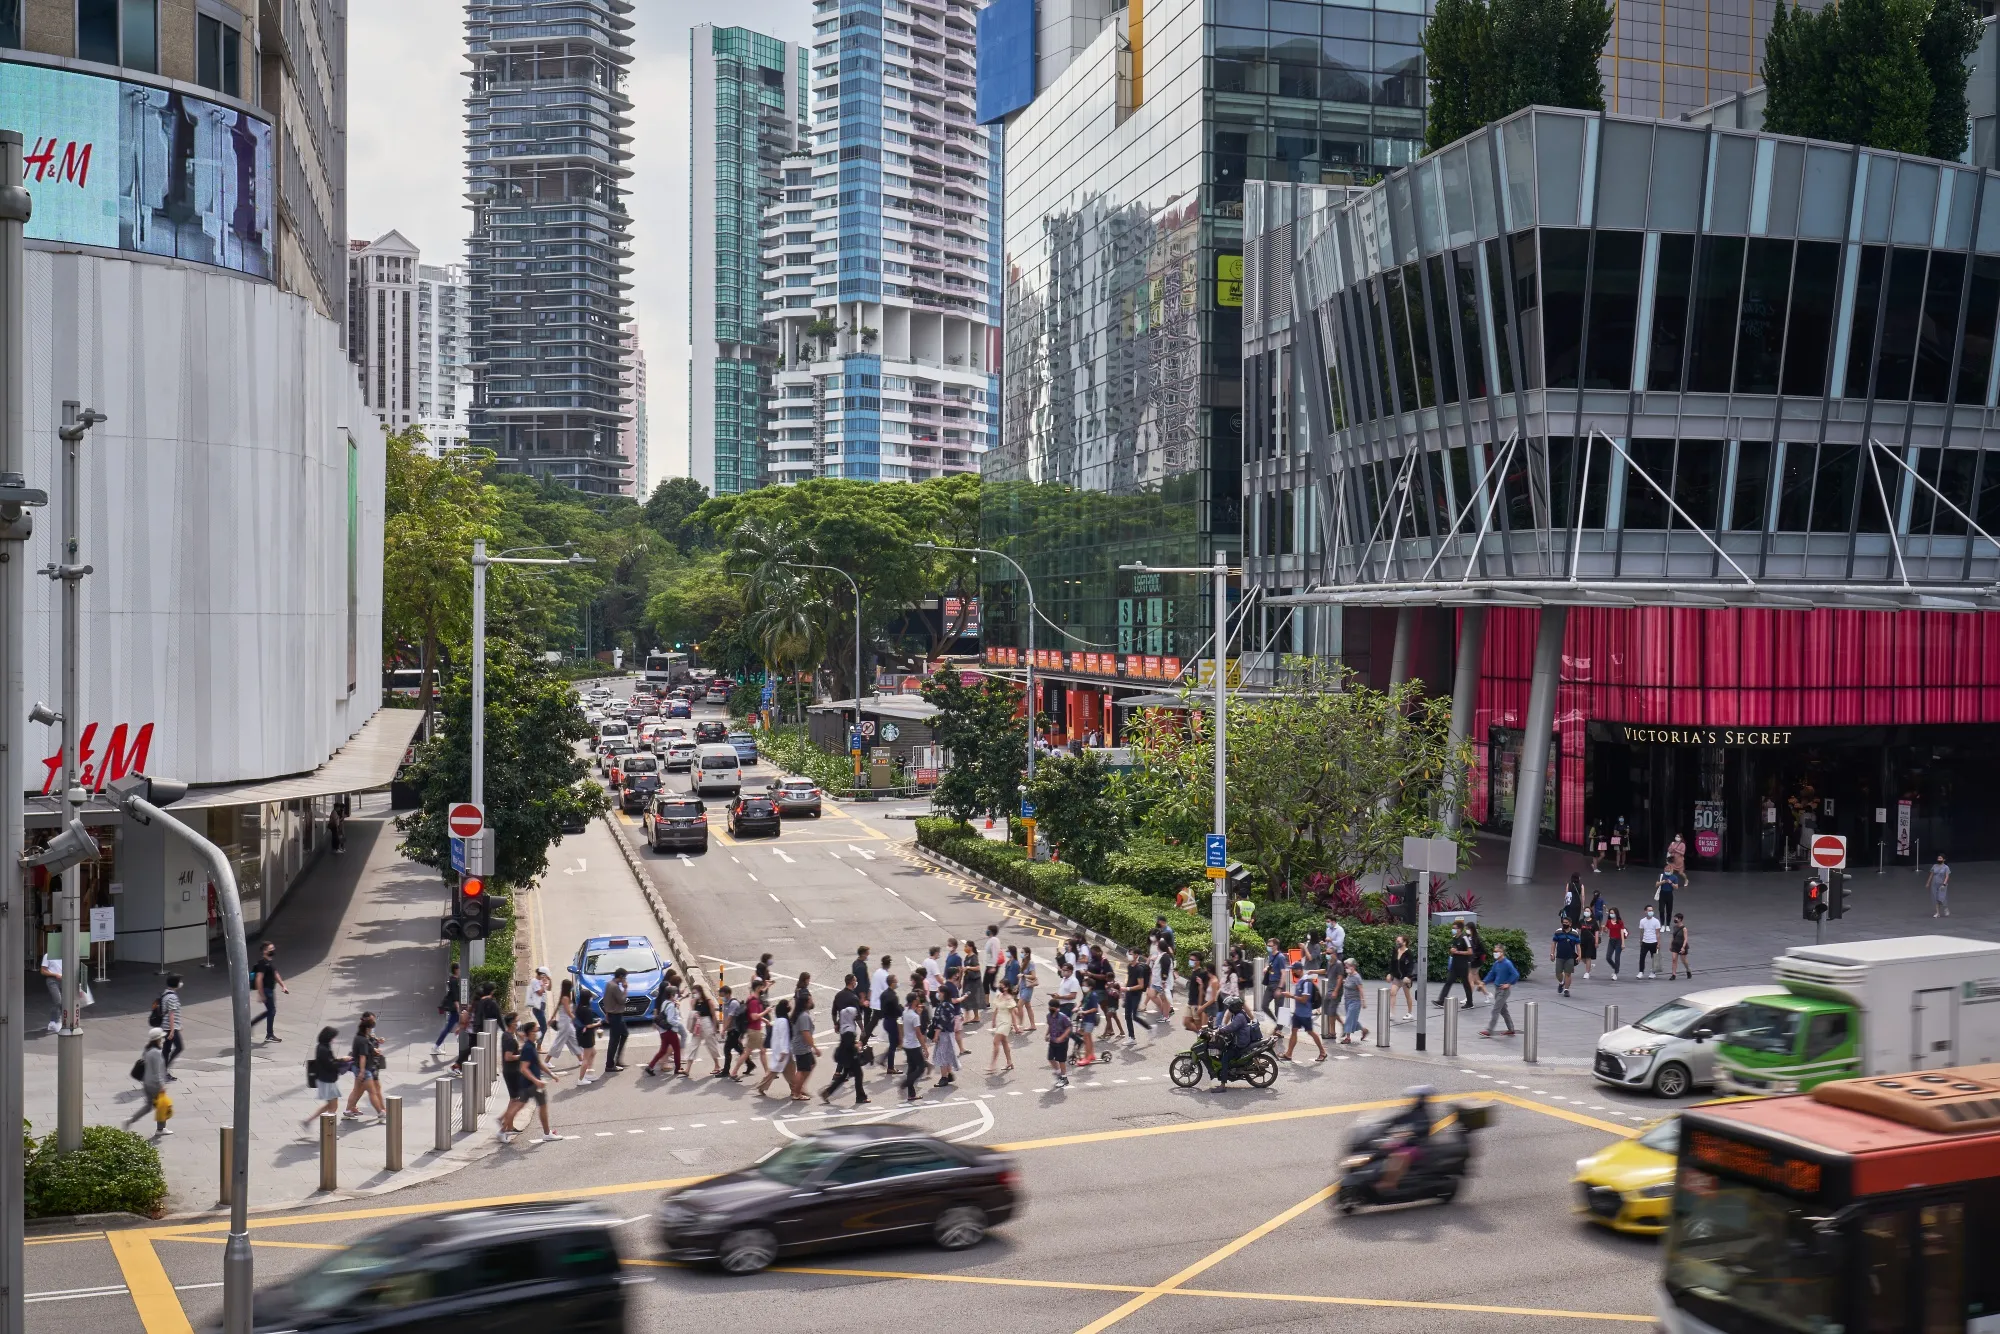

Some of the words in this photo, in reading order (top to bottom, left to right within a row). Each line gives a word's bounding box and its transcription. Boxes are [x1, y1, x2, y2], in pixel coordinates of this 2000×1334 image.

[23, 136, 92, 188] H&M
[1123, 601, 1174, 623] SALE
[1123, 629, 1174, 652] SALE
[1624, 727, 1716, 744] VICTORIA'S
[1725, 731, 1792, 745] SECRET
